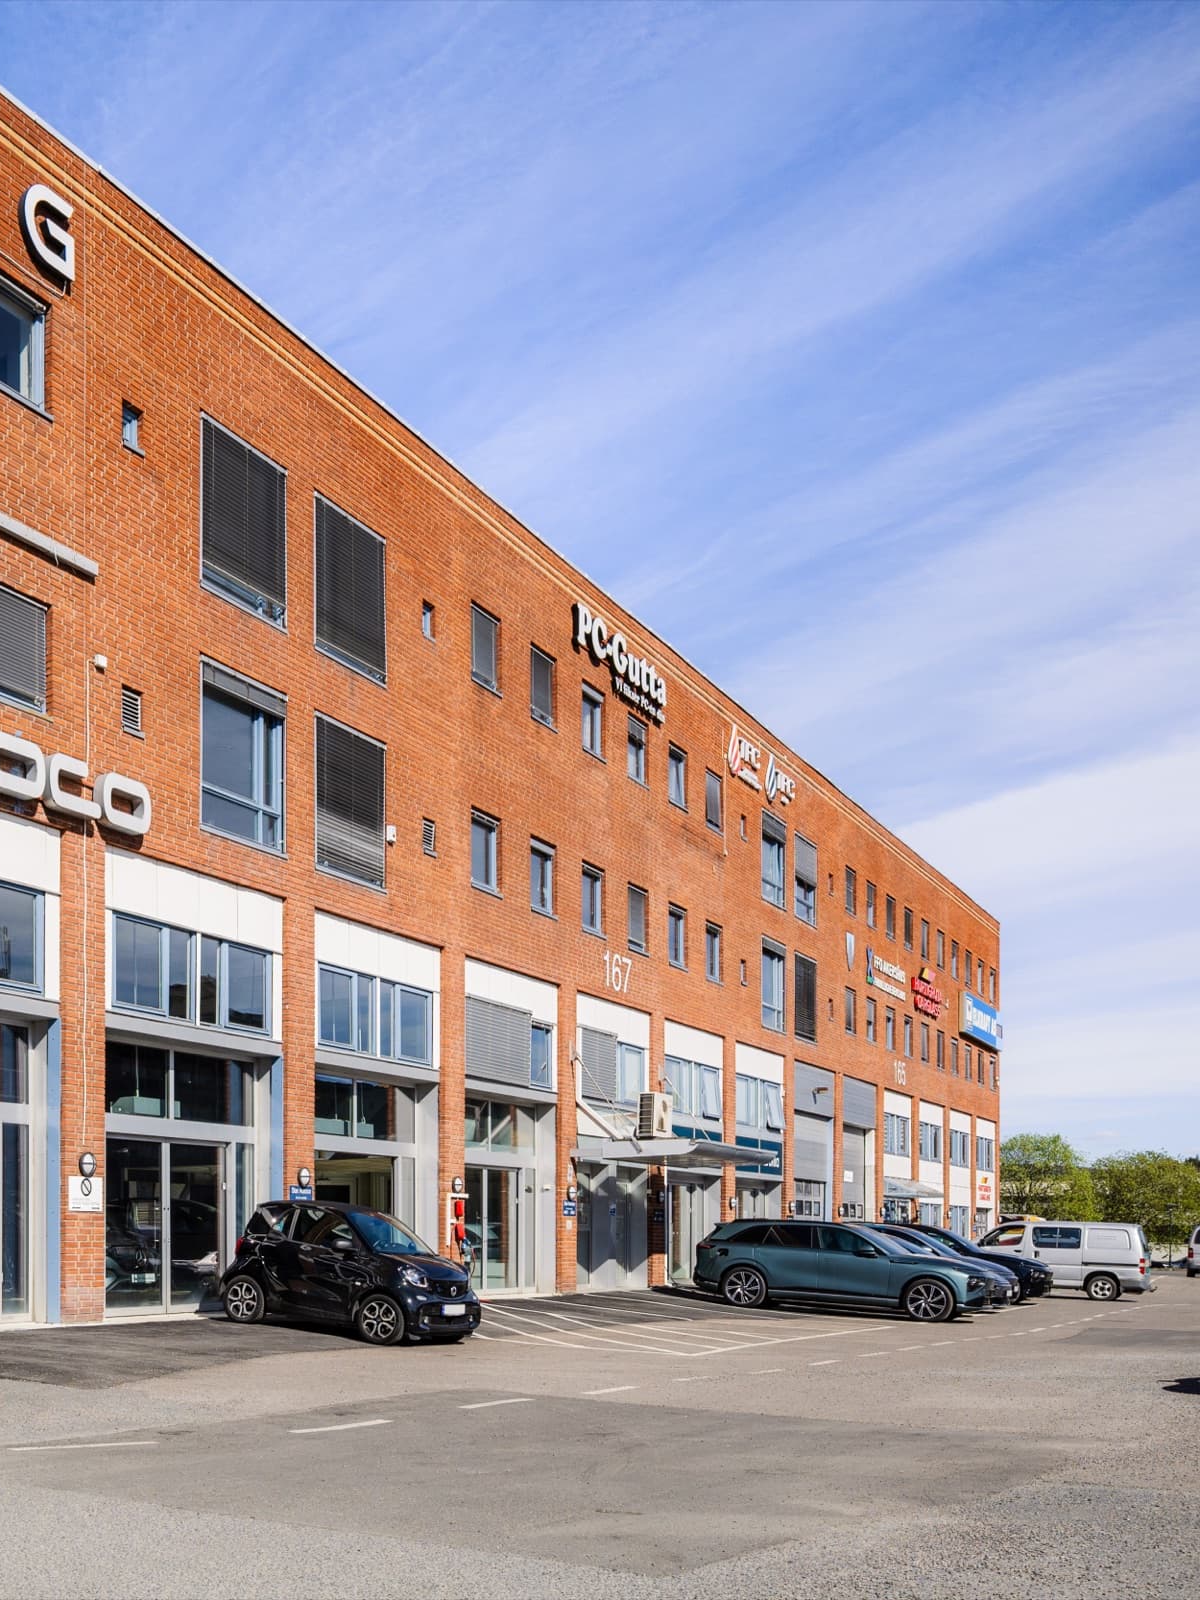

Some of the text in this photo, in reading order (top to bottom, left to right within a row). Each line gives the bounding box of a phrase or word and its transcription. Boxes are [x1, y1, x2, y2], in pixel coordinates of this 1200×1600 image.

[574, 602, 667, 707] PC-Gutta
[603, 950, 632, 993] 167
[894, 1059, 906, 1086] 165
